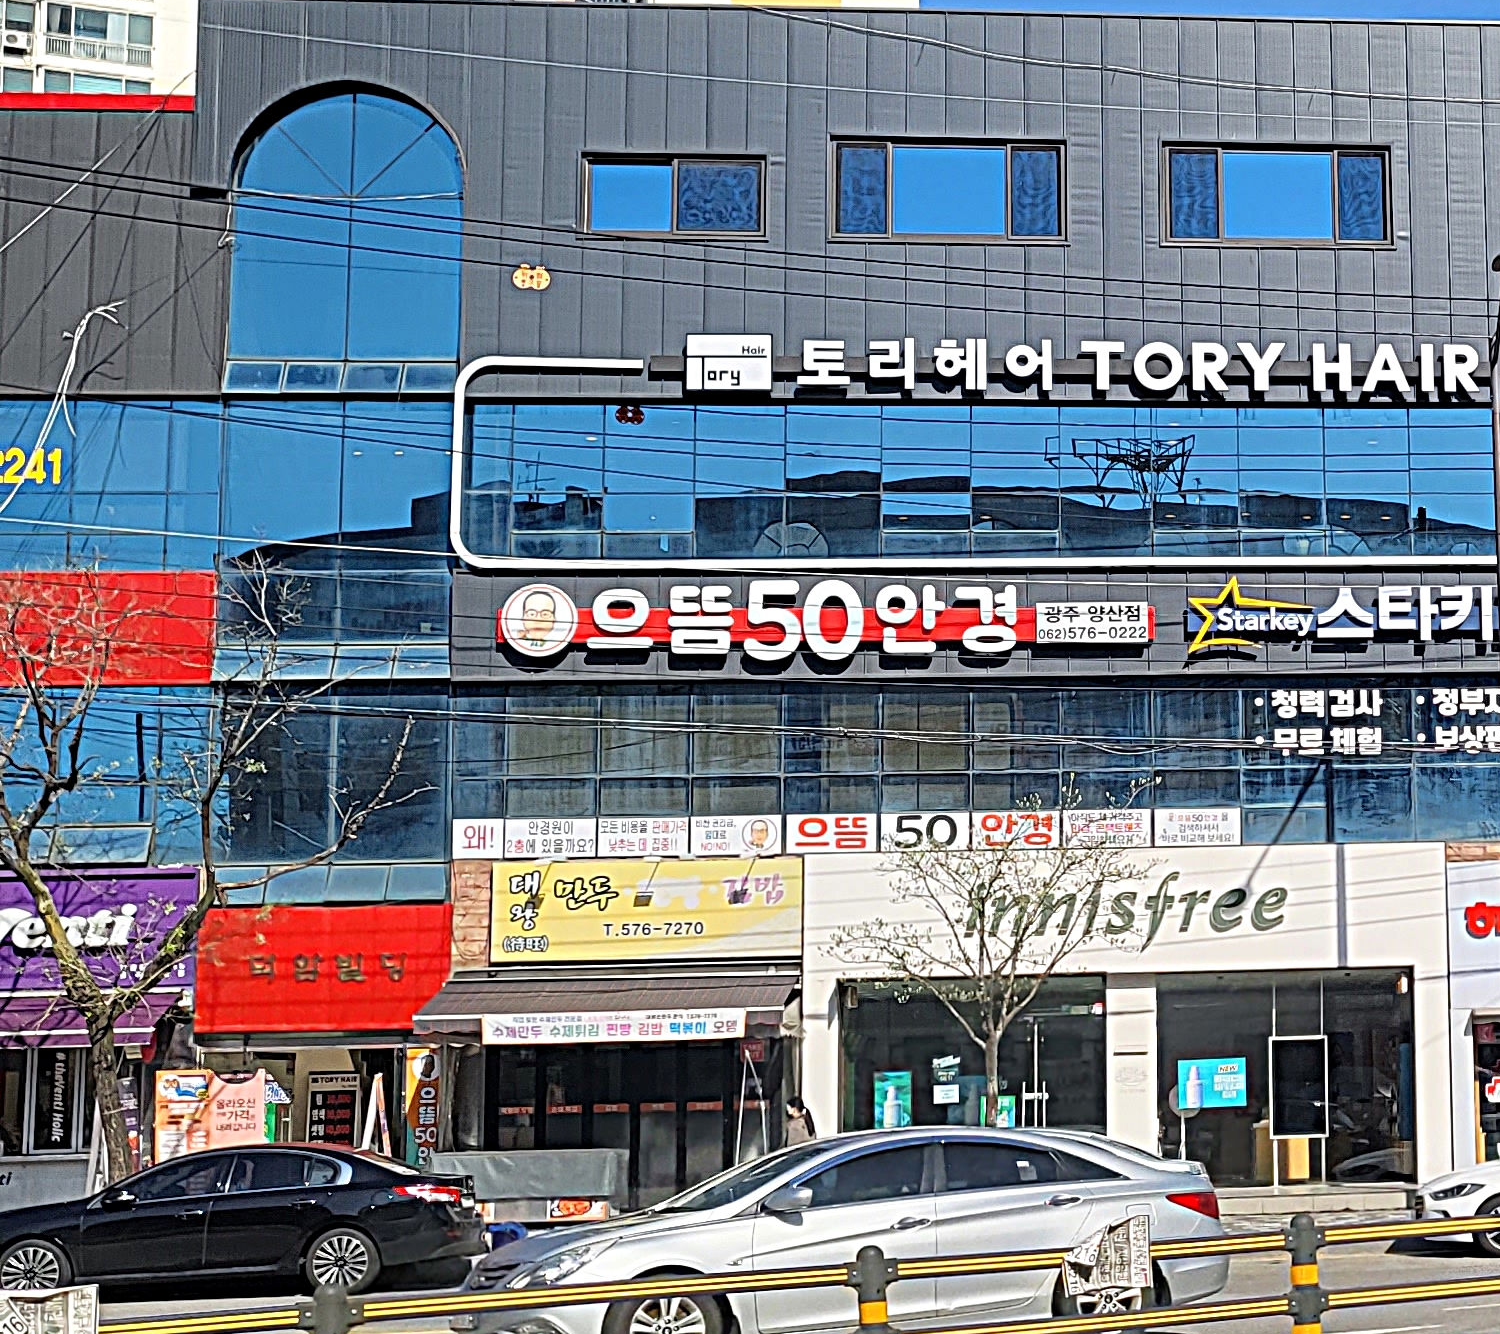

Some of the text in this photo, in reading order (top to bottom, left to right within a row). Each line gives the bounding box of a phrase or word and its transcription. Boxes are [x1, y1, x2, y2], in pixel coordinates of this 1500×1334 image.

[741, 346, 766, 356] Hair
[796, 337, 1480, 394] 토리헤어 TORY HAIR
[0, 448, 63, 485] 241
[1044, 604, 1142, 623] 광주 양산점
[1216, 606, 1314, 637] Starkey
[1037, 624, 1148, 643] 062)576-0222
[461, 825, 494, 850] 왜!
[528, 821, 574, 836] 안경원이
[600, 820, 688, 835] 모든 비용을 판매가격
[795, 810, 1054, 850] 으뜸 50 안경
[541, 837, 595, 854] 있을까요?
[608, 837, 636, 852] 낮추는
[509, 870, 542, 931] 대왕
[554, 876, 619, 911] 만두
[963, 870, 1289, 954] innisfree
[603, 921, 704, 938] T.576-7270
[492, 1025, 543, 1040] 수제만두
[549, 1023, 600, 1038] 수제튀김
[637, 1021, 663, 1036] 김밥
[669, 1020, 707, 1035] 떡볶이
[712, 1019, 738, 1034] 오뎅
